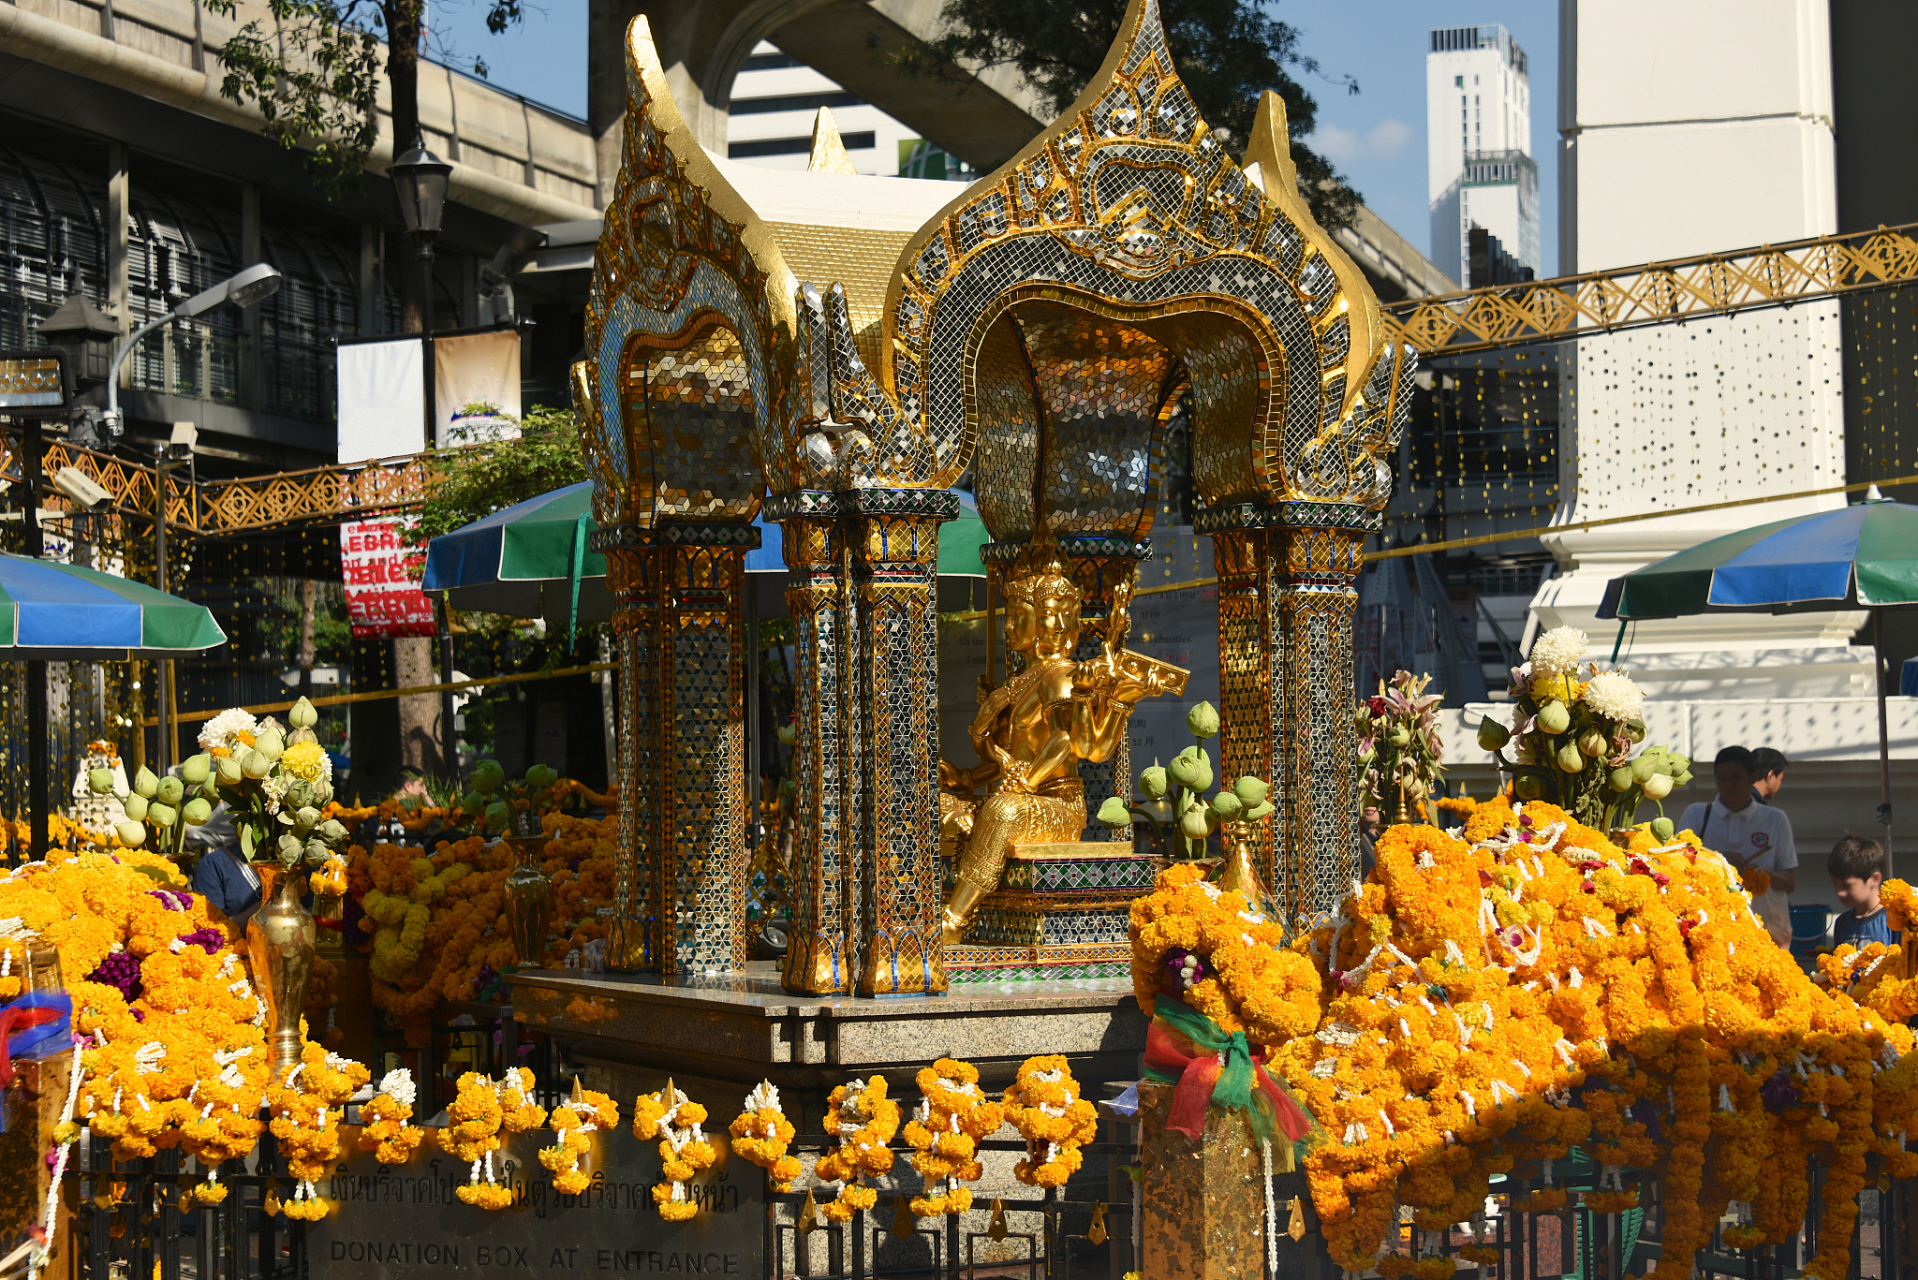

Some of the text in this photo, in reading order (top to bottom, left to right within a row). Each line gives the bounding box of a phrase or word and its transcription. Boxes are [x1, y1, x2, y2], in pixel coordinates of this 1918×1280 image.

[330, 1240, 739, 1275] DONATION BOX AT ENTRANCE
